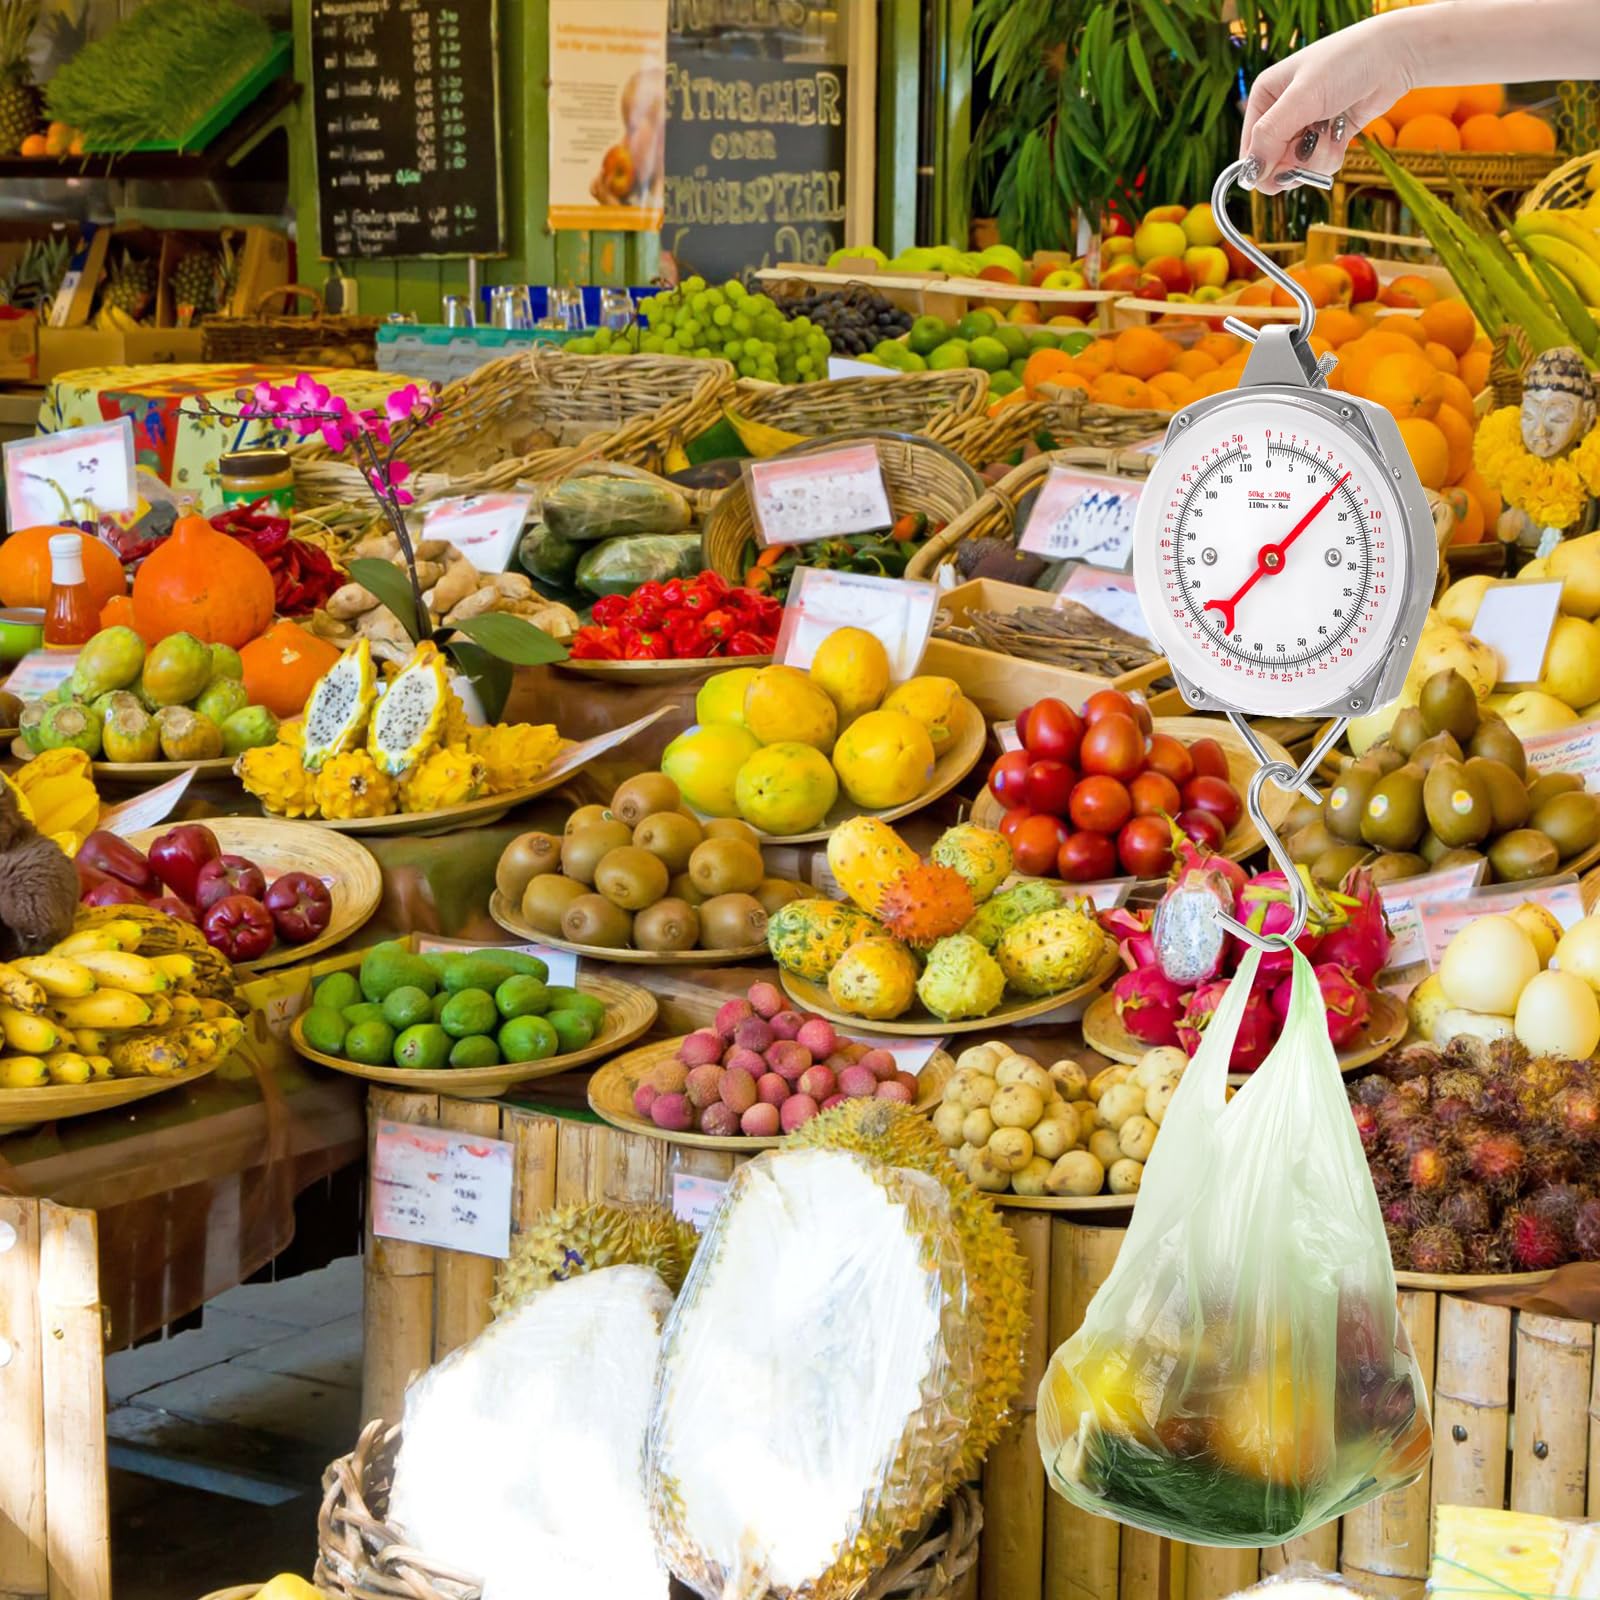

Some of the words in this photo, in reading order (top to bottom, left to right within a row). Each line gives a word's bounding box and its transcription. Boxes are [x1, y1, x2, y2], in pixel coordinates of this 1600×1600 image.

[1265, 429, 1271, 438] 0
[1232, 434, 1243, 443] 50
[1327, 452, 1333, 460] 5
[1239, 464, 1252, 472] 110
[1266, 460, 1271, 468] 0
[1288, 464, 1293, 472] 5
[1220, 475, 1233, 484] 105
[1307, 475, 1316, 483] 10
[1205, 491, 1217, 499] 100
[1248, 490, 1264, 499] 50kg
[1274, 491, 1291, 499] 200g
[1194, 509, 1203, 517] 95
[1338, 513, 1347, 521] 20
[1370, 511, 1381, 519] 10
[1187, 532, 1196, 541] 90
[1346, 536, 1355, 545] 25
[1187, 557, 1195, 565] 85
[1347, 562, 1357, 571] 30
[1192, 580, 1200, 589] 80
[1343, 588, 1352, 597] 35
[1374, 586, 1386, 594] 15
[1174, 609, 1184, 618] 35
[1333, 609, 1342, 617] 40
[1216, 620, 1225, 629] 70
[1317, 626, 1327, 634] 45
[1233, 634, 1242, 642] 65
[1297, 638, 1306, 646] 50
[1254, 643, 1263, 651] 60
[1276, 644, 1286, 652] 55
[1341, 648, 1353, 656] 20
[1220, 659, 1231, 667] 30
[1281, 674, 1293, 682] 25
